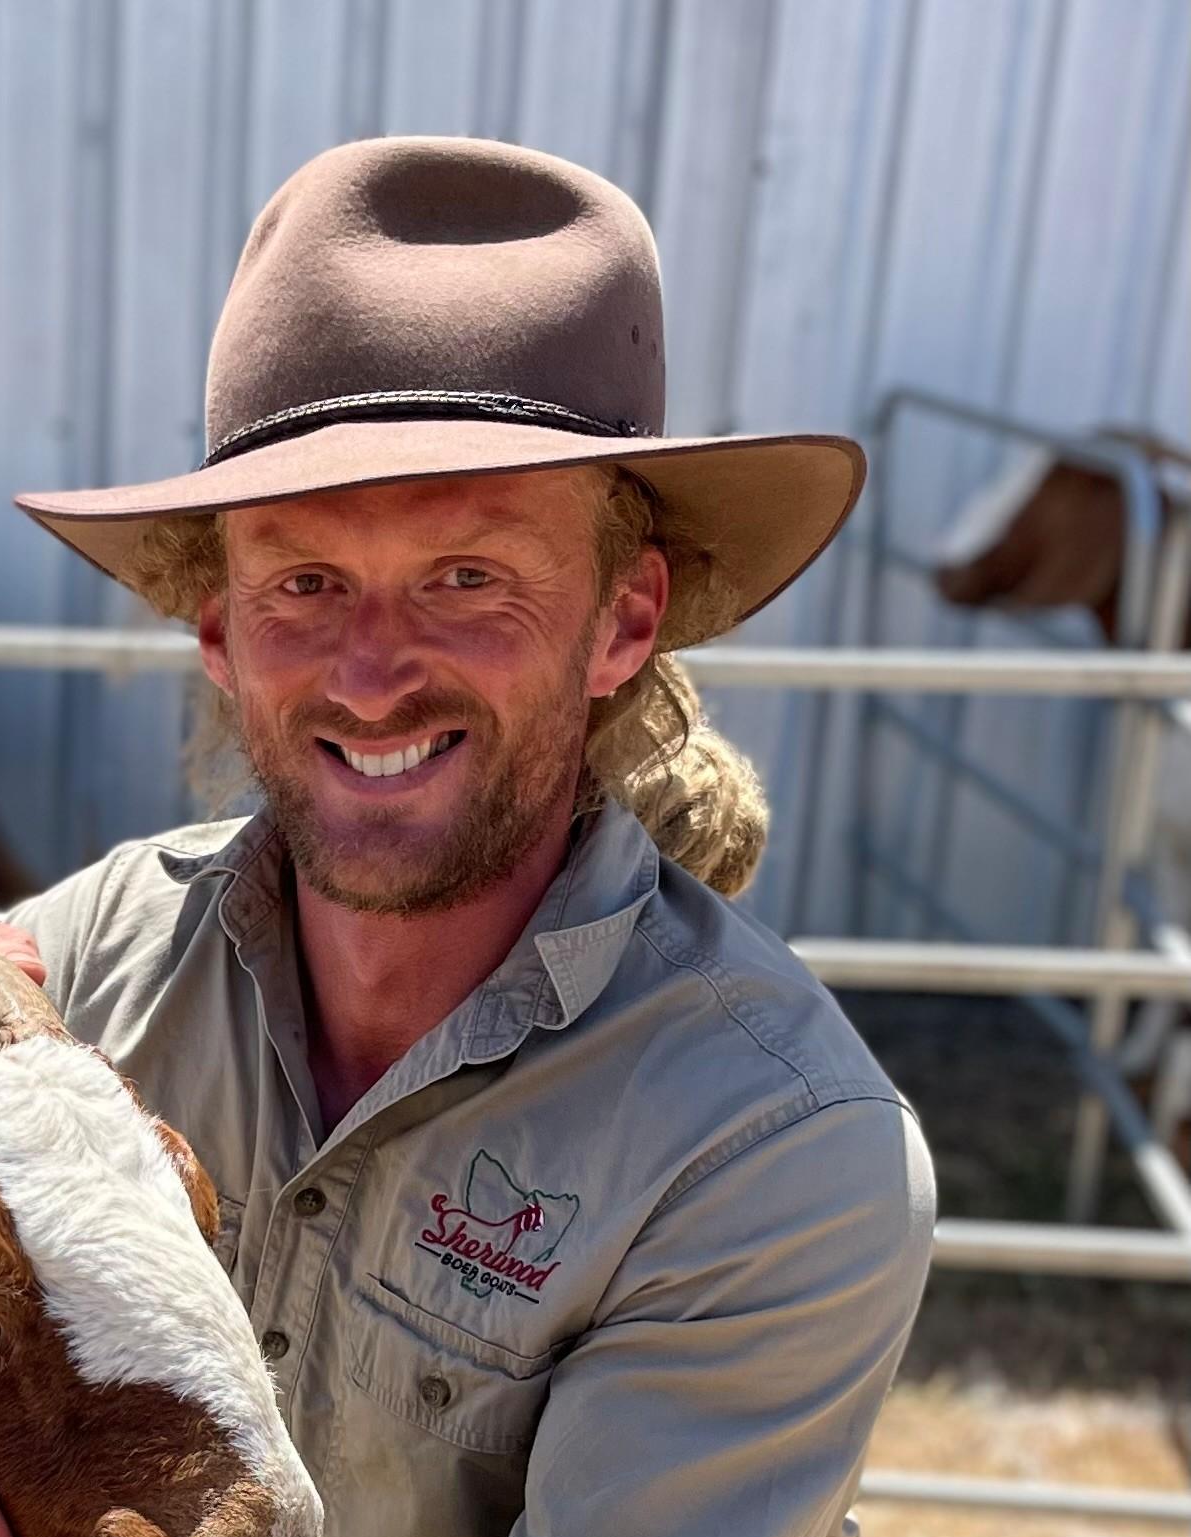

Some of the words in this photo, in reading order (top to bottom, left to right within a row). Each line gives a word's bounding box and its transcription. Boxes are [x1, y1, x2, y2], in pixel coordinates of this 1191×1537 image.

[422, 1207, 561, 1292] Sherwood
[440, 1252, 479, 1282] BOER
[480, 1272, 516, 1297] GOATS
